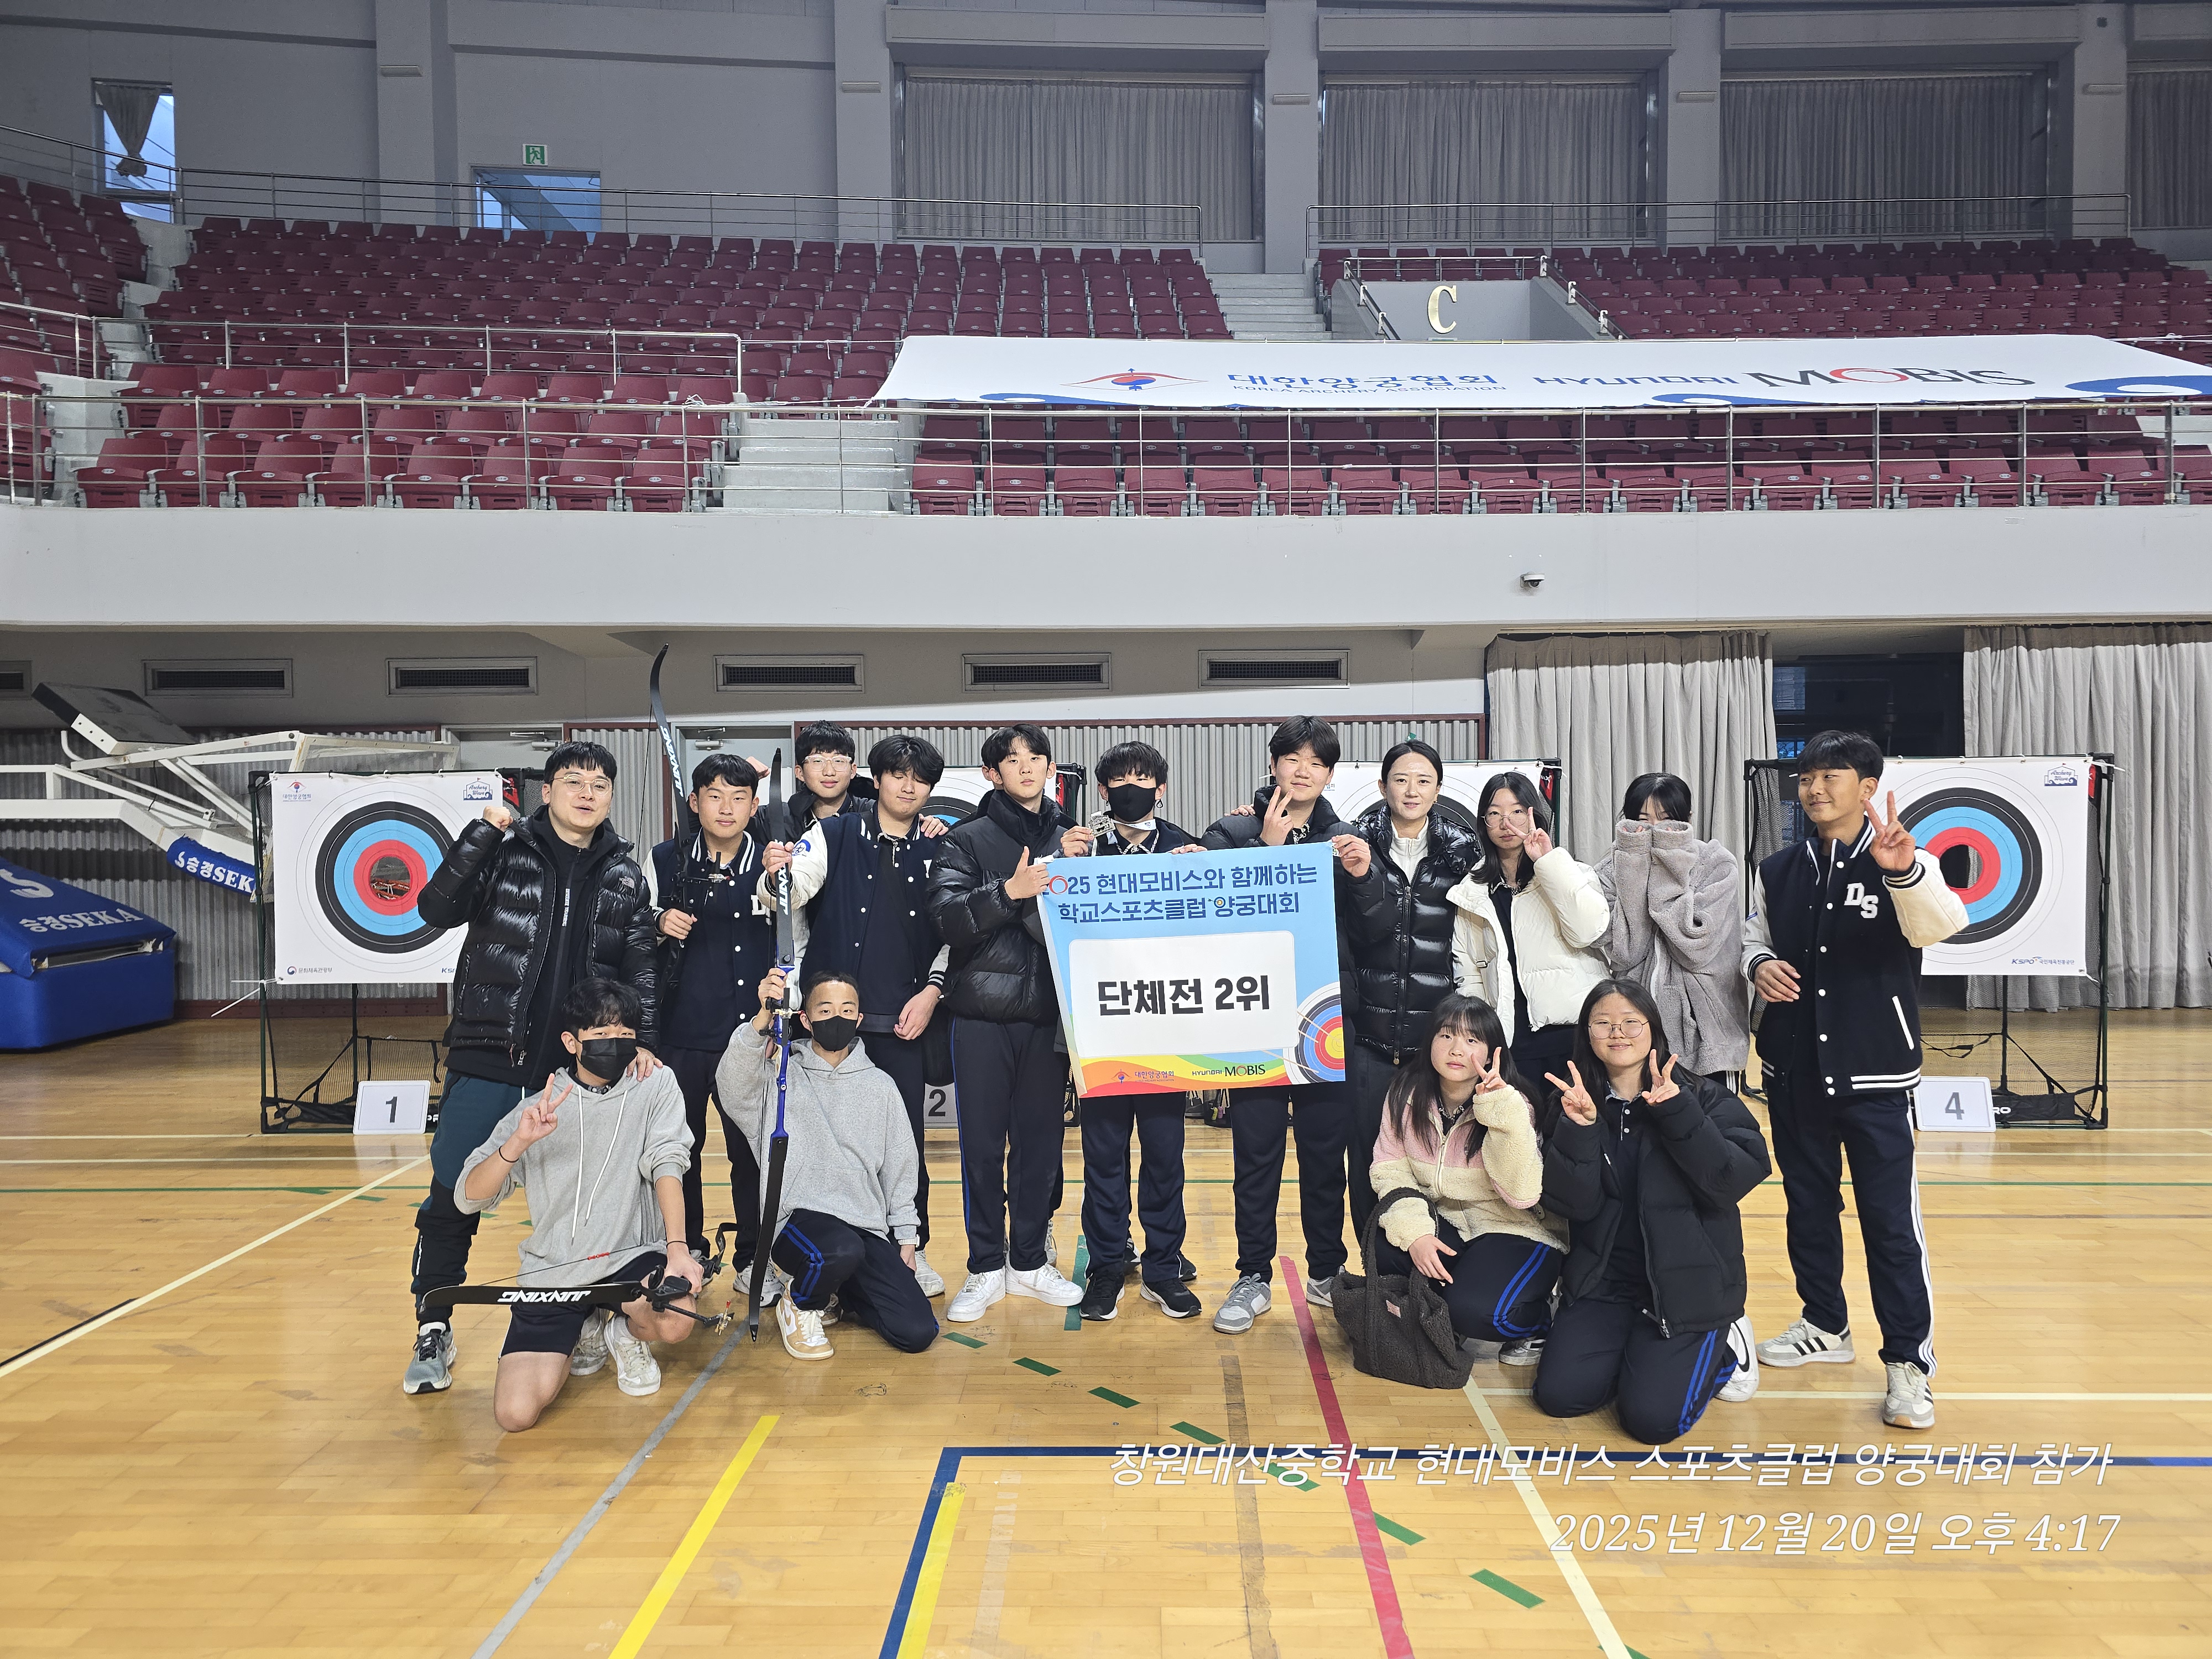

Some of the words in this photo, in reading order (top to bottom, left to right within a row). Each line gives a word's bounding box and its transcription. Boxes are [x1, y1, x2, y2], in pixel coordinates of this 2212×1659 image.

[1427, 285, 1457, 333] C
[1227, 374, 1498, 389] 대한양궁협회
[1532, 376, 1740, 385] HYUNDAI
[1742, 368, 2036, 387] MOBIS
[660, 725, 684, 797] JUNXING
[186, 857, 254, 893] 승경SEK
[1042, 875, 1090, 895] 025
[1096, 867, 1225, 895] 현대모비스와
[1230, 863, 1318, 888] 함께하는
[1058, 896, 1207, 924] 학교스포츠클럽
[1213, 892, 1300, 917] 양궁대회
[1844, 882, 1879, 919] DS
[19, 908, 144, 932] 승경SEKA
[1098, 978, 1203, 1016] 단체전
[1215, 975, 1270, 1012] 2위
[1135, 1071, 1174, 1079] 대한양궁협회
[1224, 1064, 1266, 1077] MOBIS
[385, 1096, 398, 1123] 1
[928, 1089, 946, 1117] 2
[1945, 1092, 1965, 1120] 4
[497, 1290, 591, 1302] JUNXING
